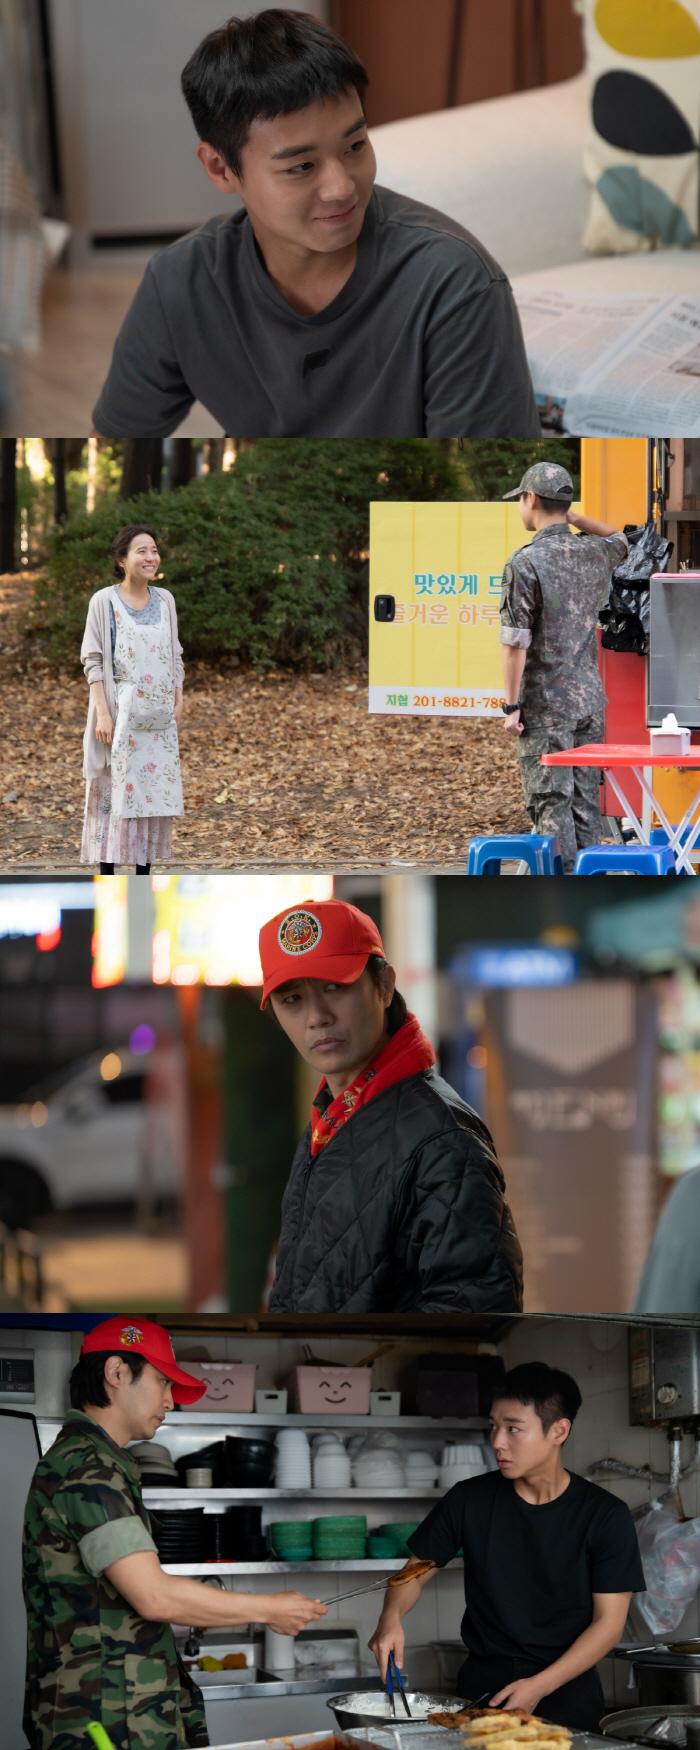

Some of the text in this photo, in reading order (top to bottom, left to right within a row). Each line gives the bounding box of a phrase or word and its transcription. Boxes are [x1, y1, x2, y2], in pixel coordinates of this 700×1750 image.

[414, 573, 478, 596] 맛있게
[458, 604, 501, 626] 하루
[281, 931, 318, 952] MARINE CORPS
